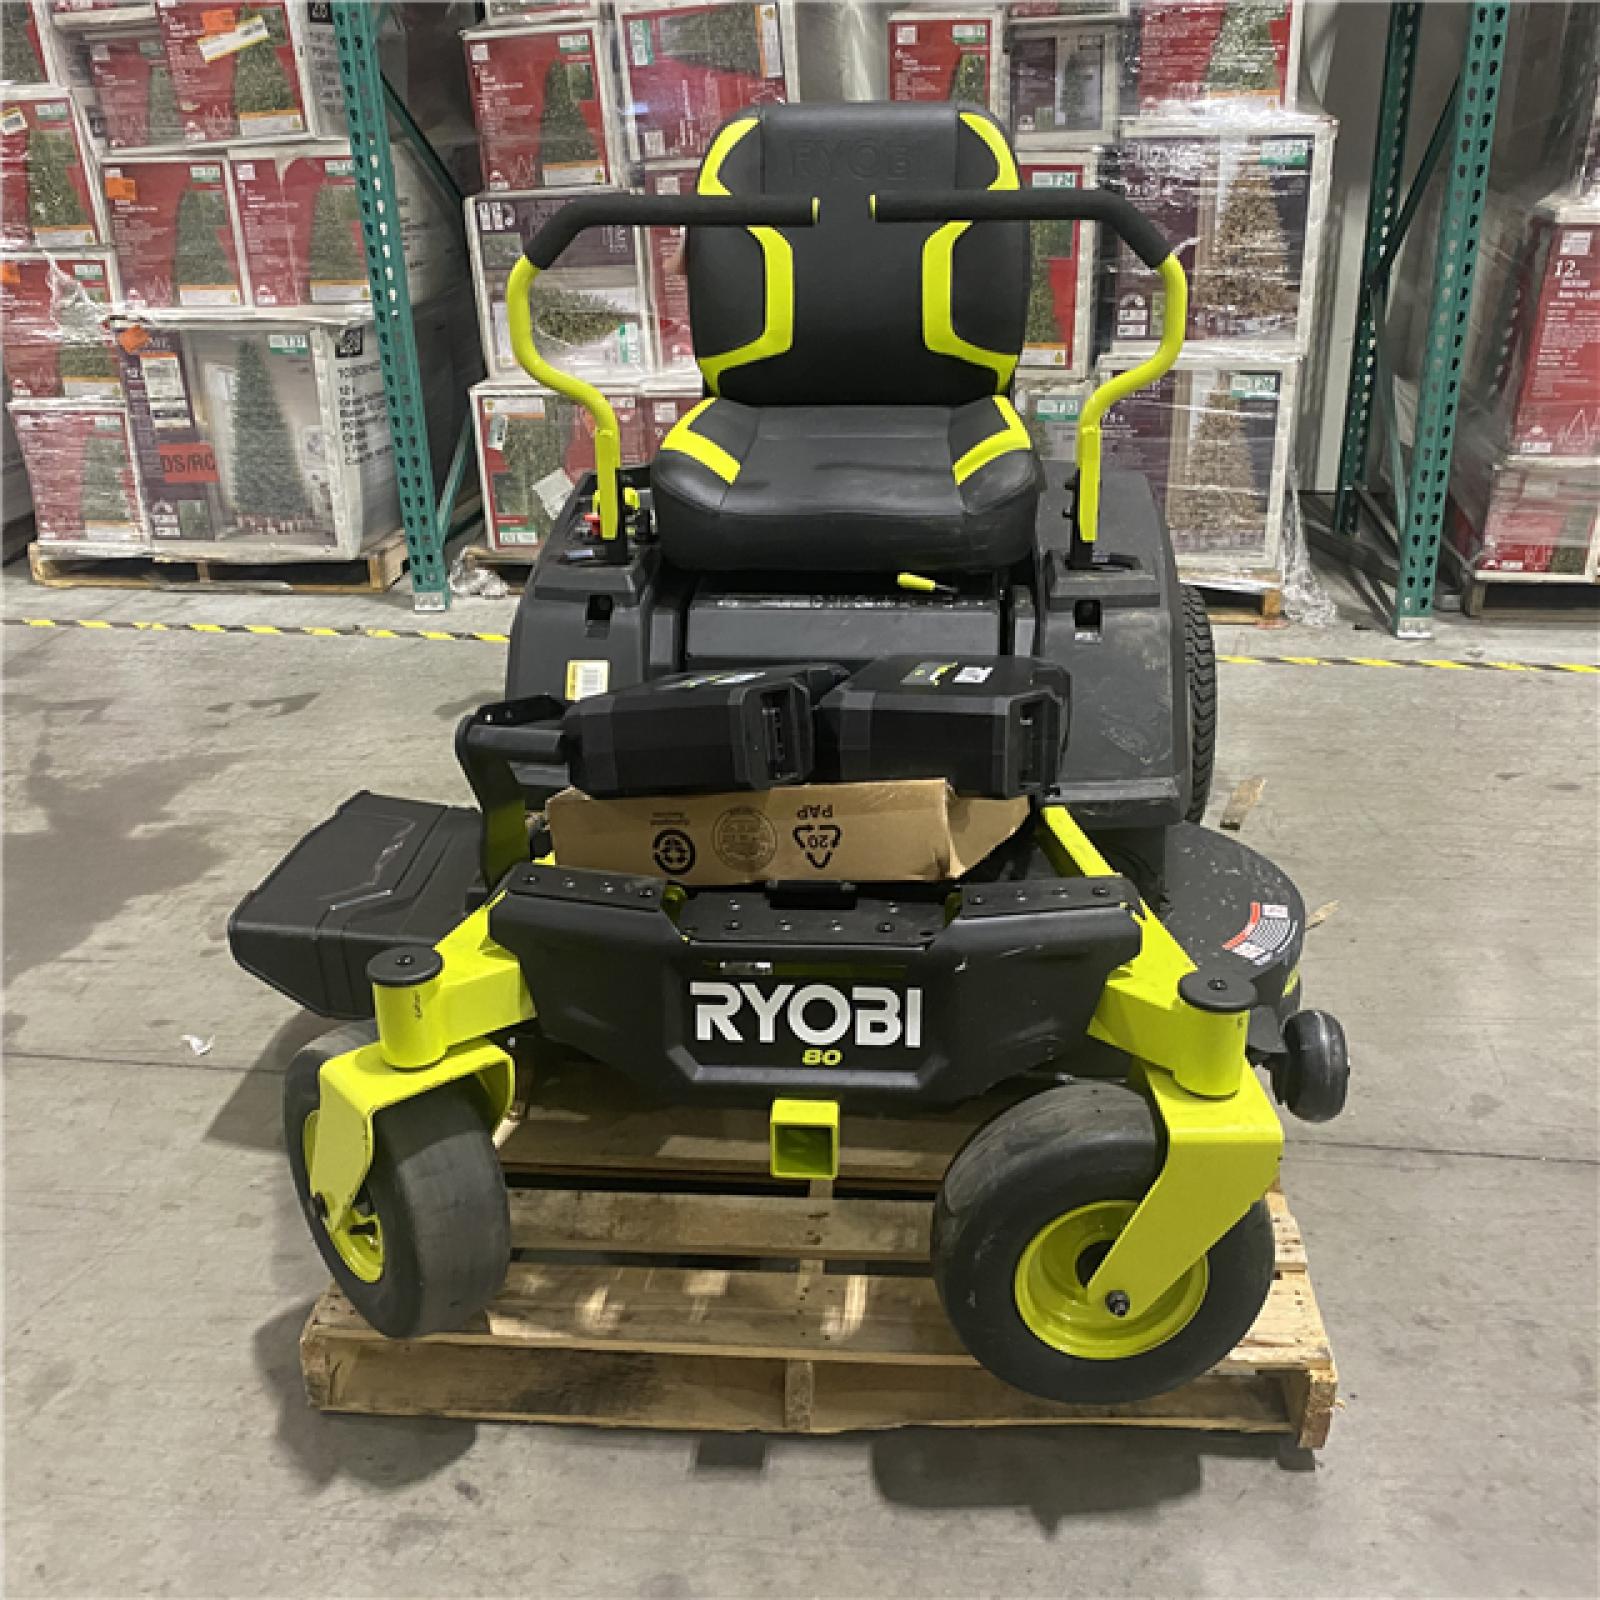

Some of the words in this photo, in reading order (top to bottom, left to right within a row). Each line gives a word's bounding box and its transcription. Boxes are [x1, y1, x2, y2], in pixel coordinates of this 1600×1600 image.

[787, 139, 928, 182] RYOB
[797, 805, 833, 819] PAP
[807, 835, 828, 848] 20
[690, 981, 922, 1049] RYOBI
[802, 1050, 842, 1066] 80
